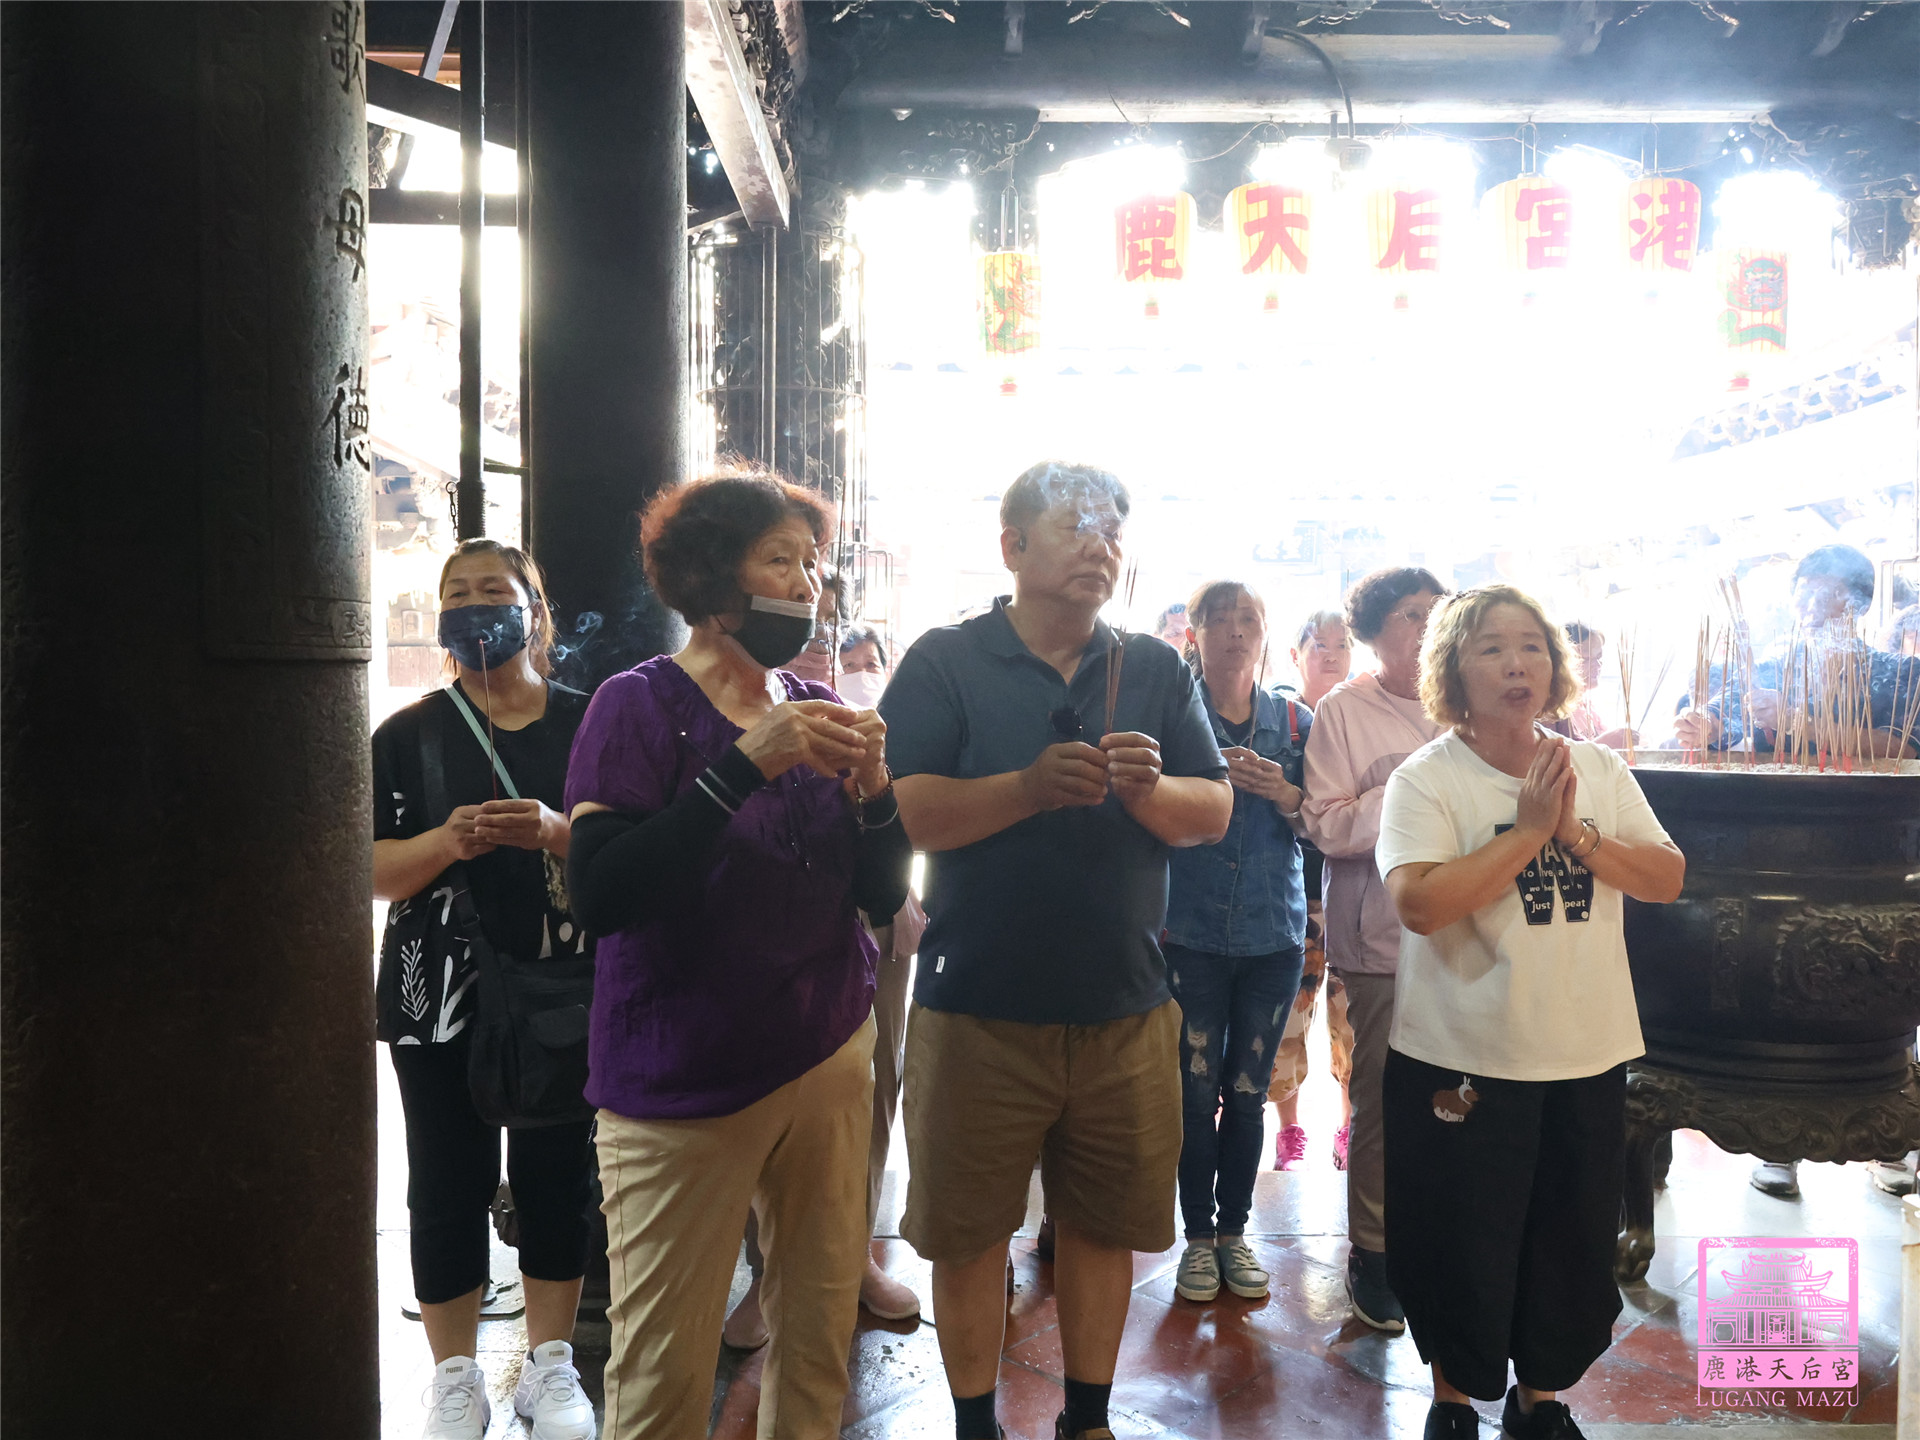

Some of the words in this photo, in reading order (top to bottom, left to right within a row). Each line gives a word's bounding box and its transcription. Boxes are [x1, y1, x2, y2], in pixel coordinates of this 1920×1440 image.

[1242, 184, 1311, 275] 天
[1375, 189, 1440, 271] 后
[1532, 901, 1551, 913] just
[1565, 899, 1586, 910] peat
